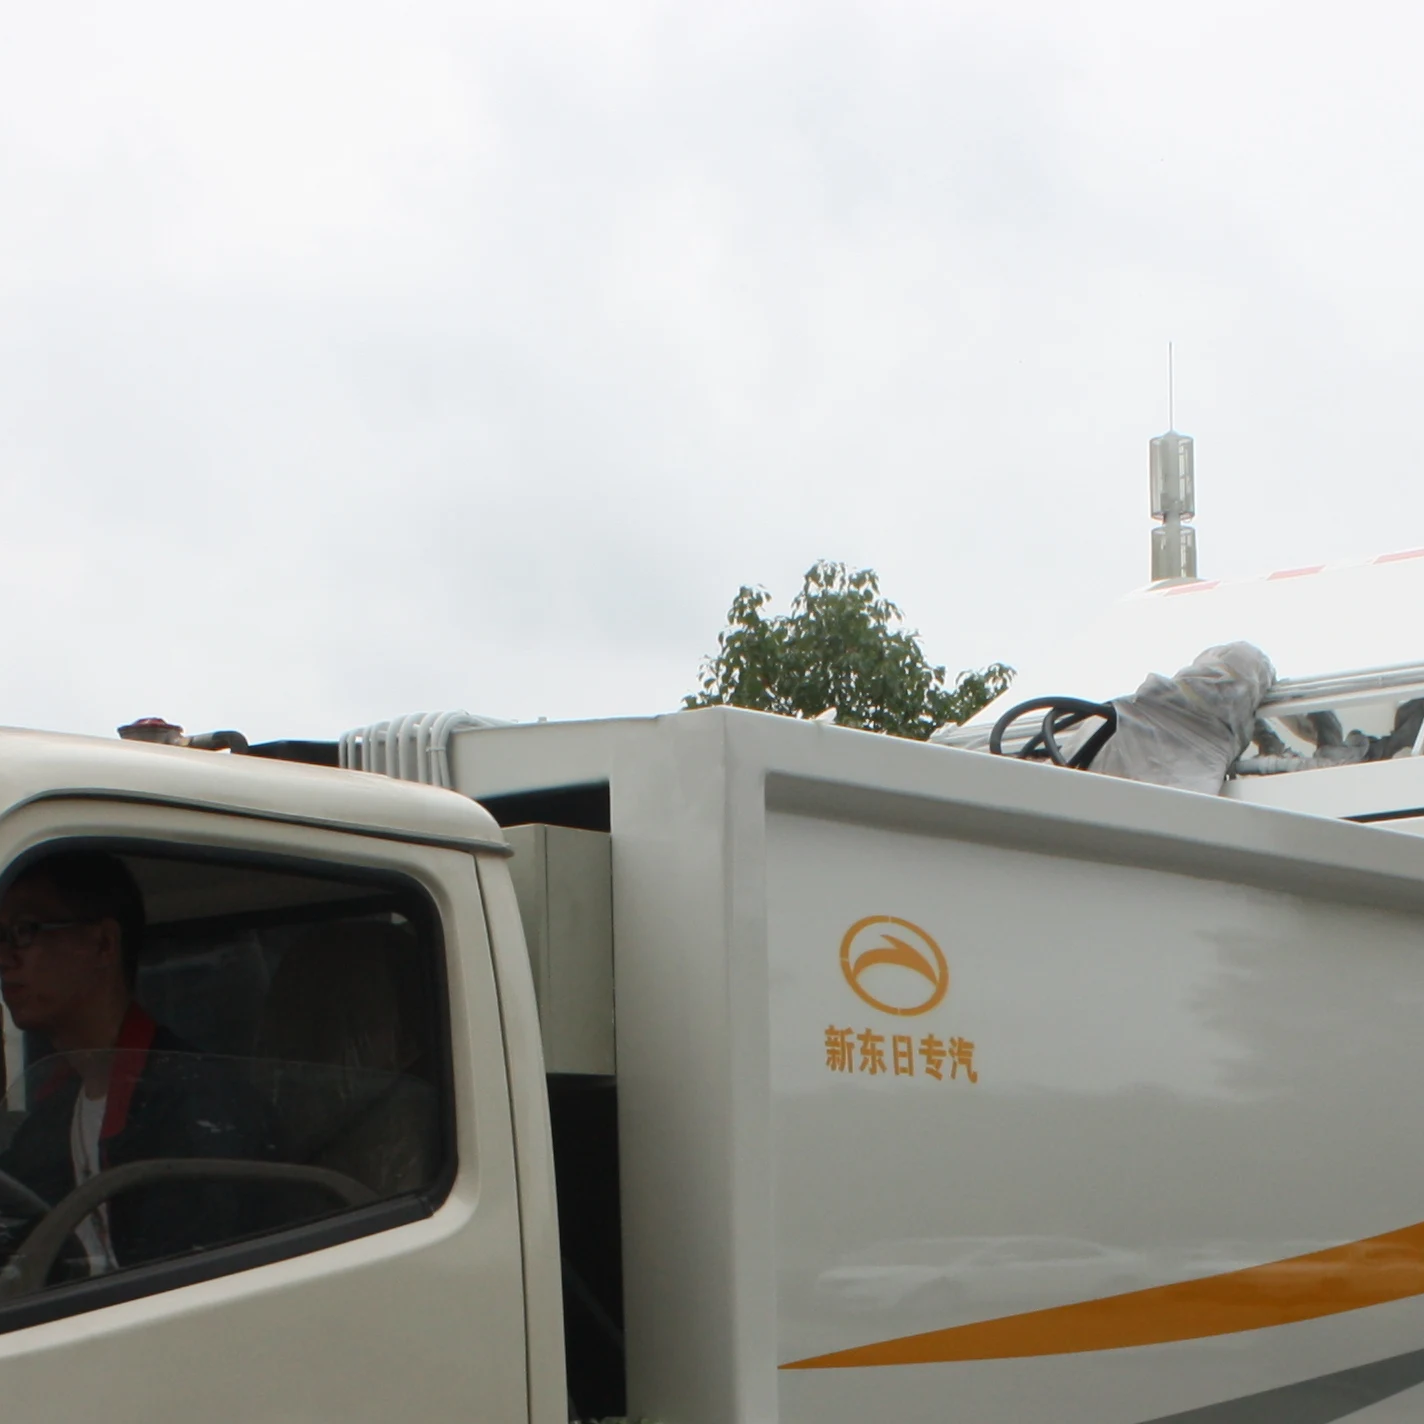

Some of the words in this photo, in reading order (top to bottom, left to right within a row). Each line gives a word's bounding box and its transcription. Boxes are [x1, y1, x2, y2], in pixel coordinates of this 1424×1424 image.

[824, 1024, 978, 1084] 新东日专汽
